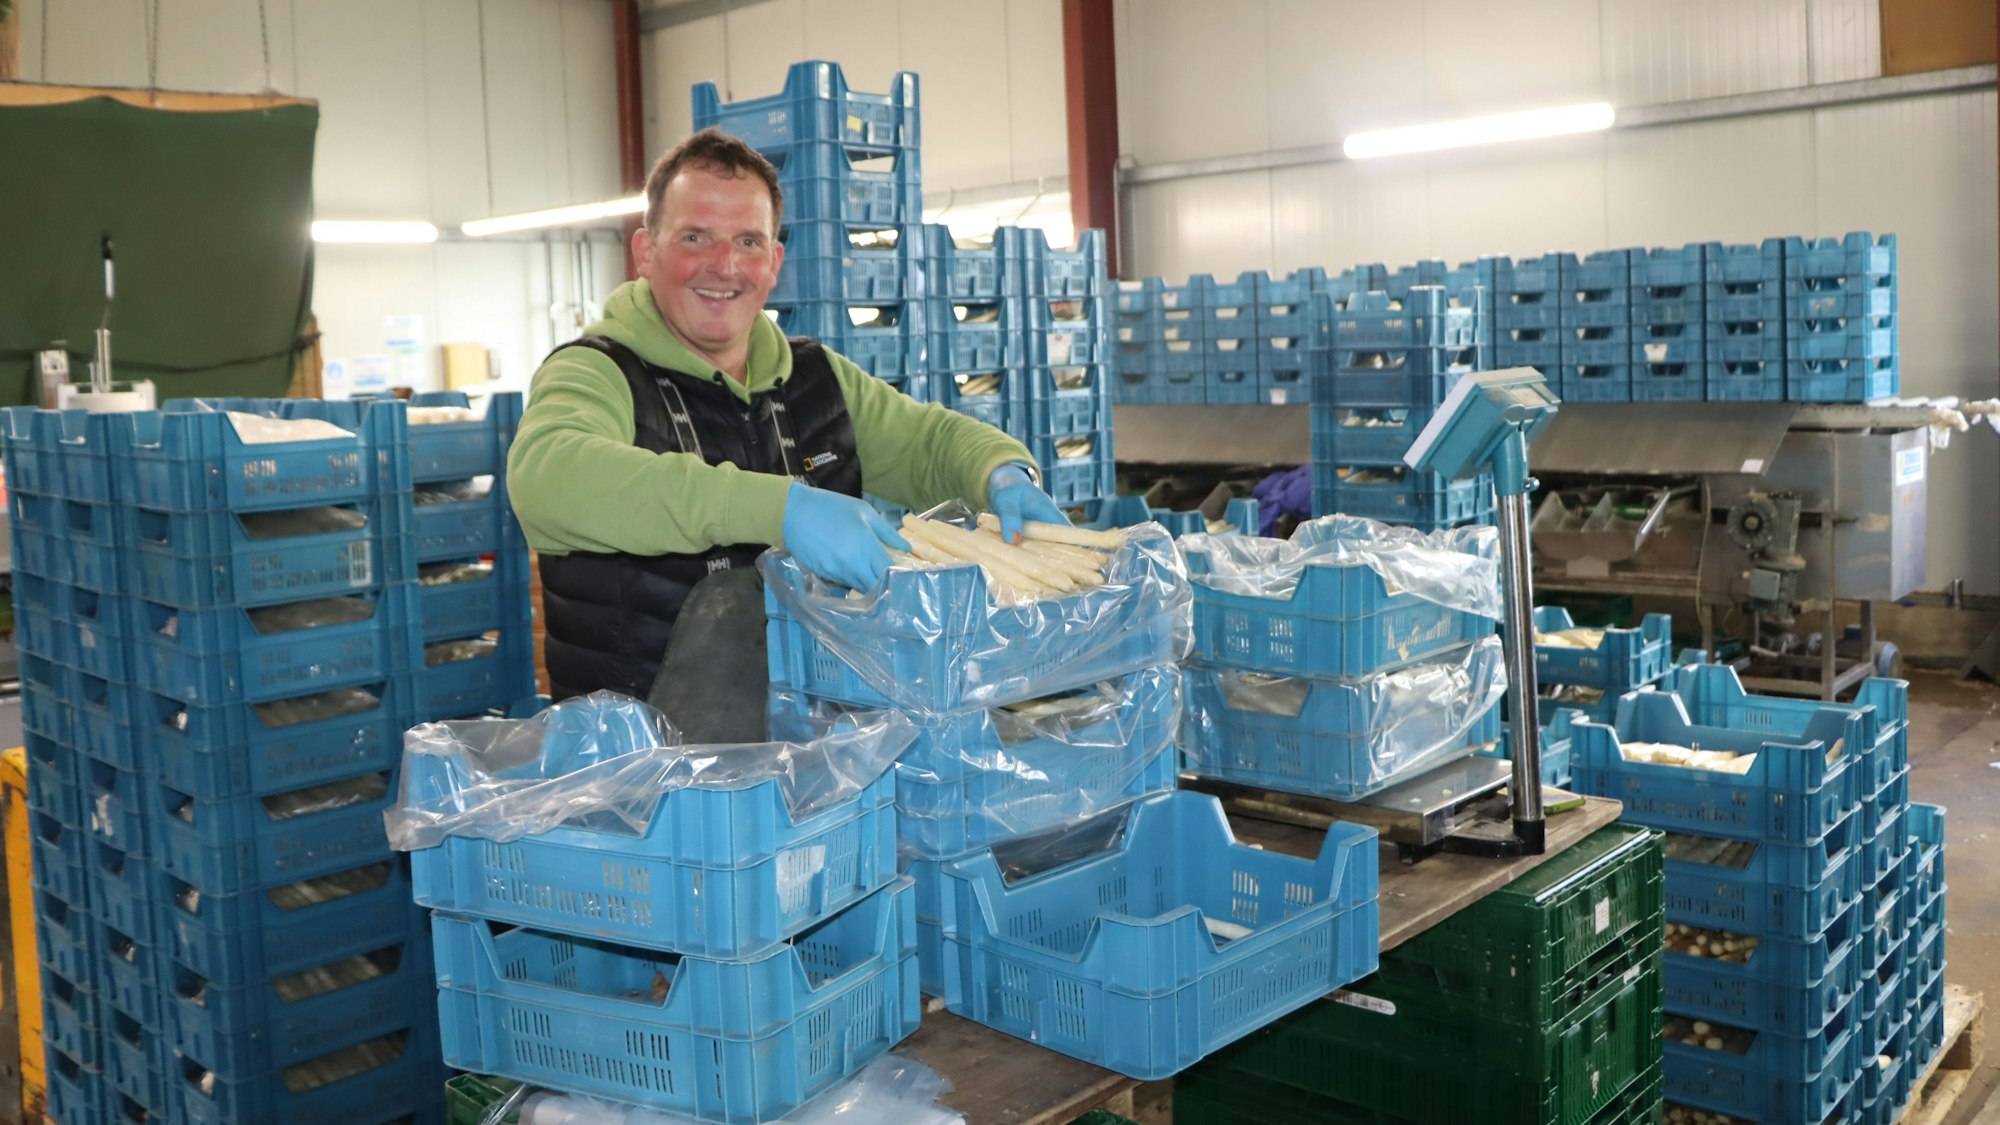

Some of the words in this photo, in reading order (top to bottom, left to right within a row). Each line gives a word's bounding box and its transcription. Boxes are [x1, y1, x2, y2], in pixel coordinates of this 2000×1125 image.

[773, 402, 785, 412] HH
[672, 413, 688, 423] HH
[781, 437, 795, 448] HH
